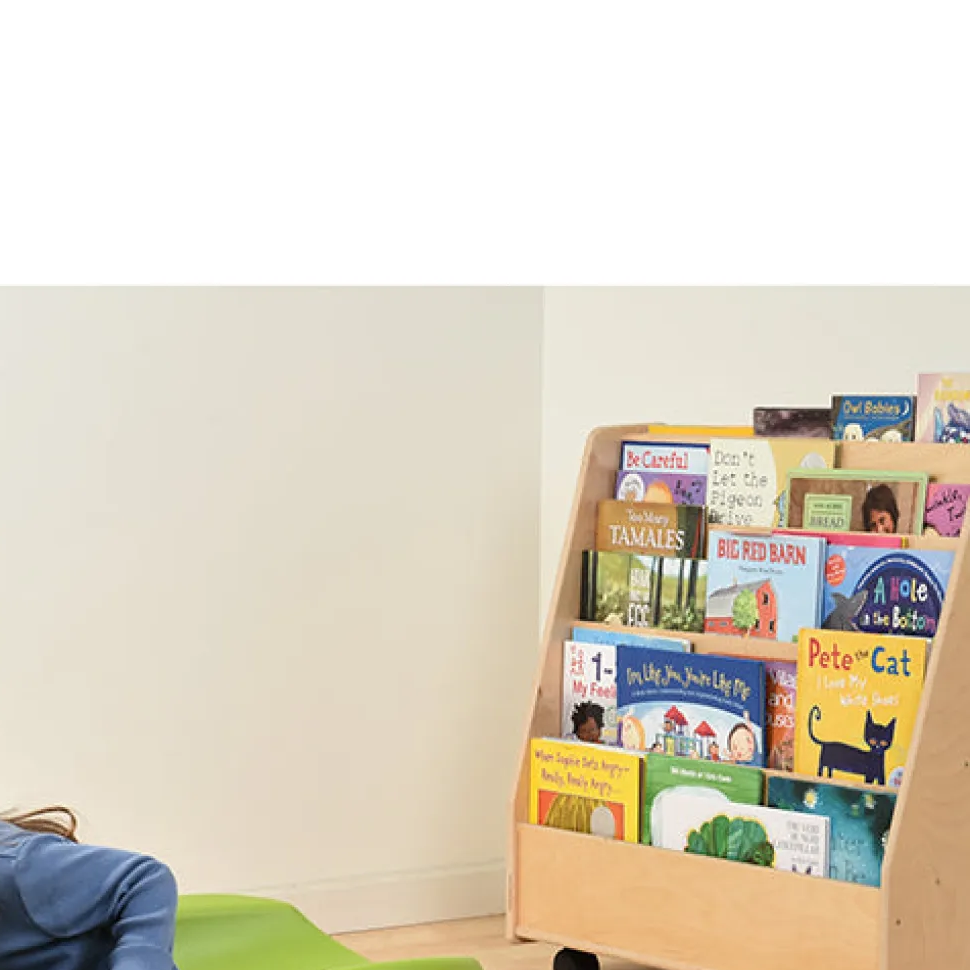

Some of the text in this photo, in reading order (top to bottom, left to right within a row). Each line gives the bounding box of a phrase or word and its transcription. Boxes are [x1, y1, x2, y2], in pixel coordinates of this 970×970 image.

[843, 400, 900, 414] Owl Babies
[626, 451, 689, 469] Be Careful
[714, 450, 755, 467] Don't
[712, 470, 768, 488] Let the
[711, 490, 763, 509] Pigeon
[607, 524, 686, 551] TAMALES
[717, 538, 807, 566] BIG RED BARN
[873, 577, 928, 605] A Hole
[873, 611, 889, 627] the
[808, 637, 911, 677] Pete the Cat
[572, 680, 587, 698] My
